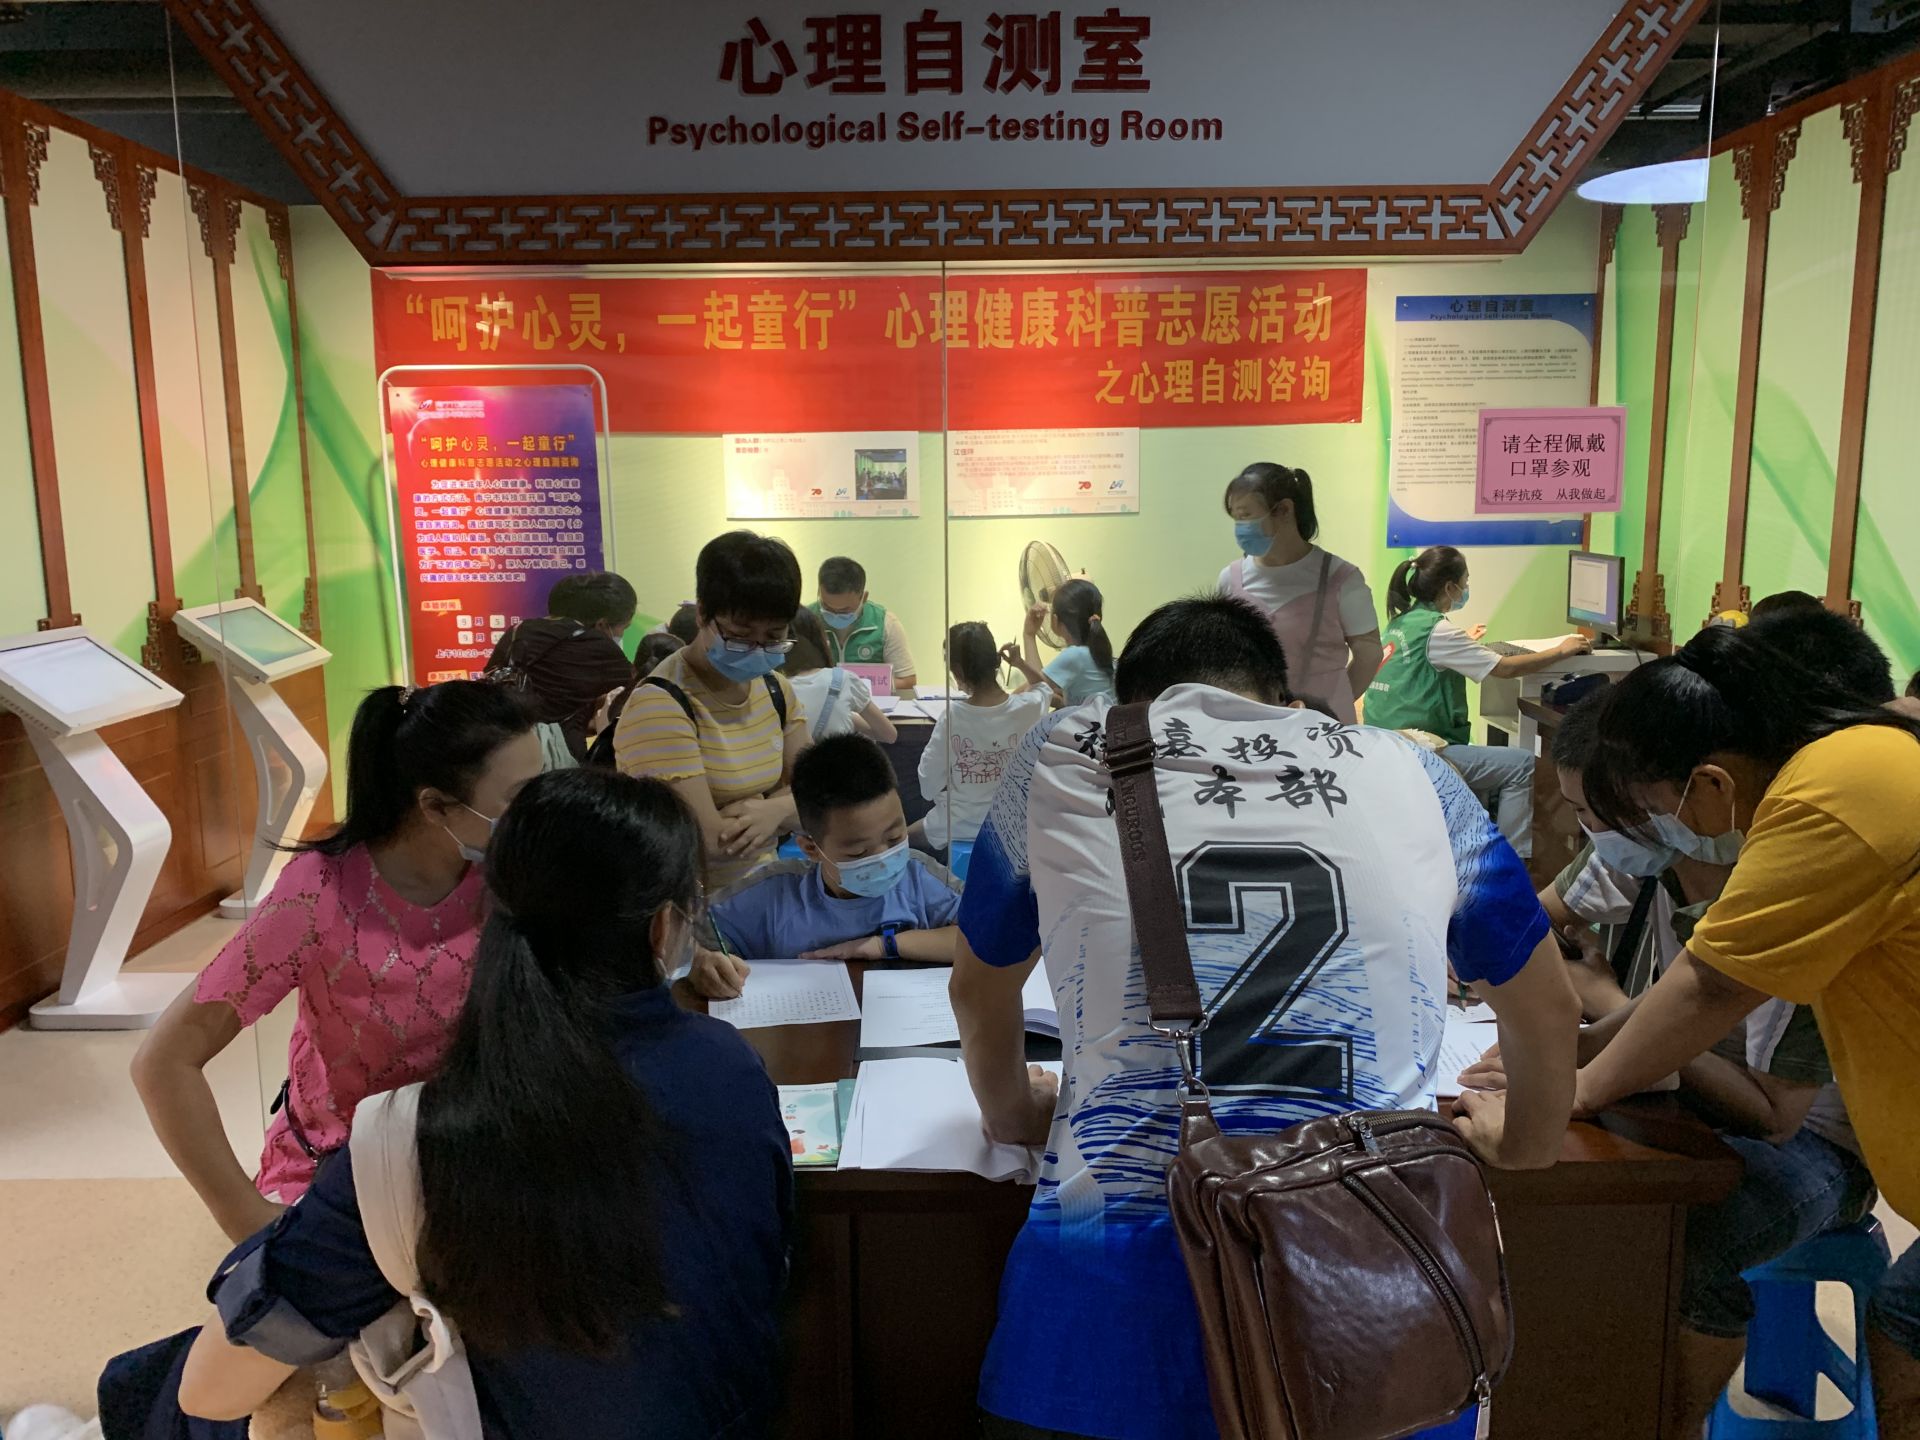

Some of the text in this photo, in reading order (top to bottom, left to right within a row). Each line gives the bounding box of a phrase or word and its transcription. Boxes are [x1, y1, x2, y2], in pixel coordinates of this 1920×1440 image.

[719, 8, 1151, 95] 心理自测室
[648, 109, 1224, 152] Psychological Self-testing Room
[1450, 299, 1534, 313] 心理自测室
[1095, 354, 1331, 405] 之心理自测咨询
[1502, 433, 1605, 454] 请全程佩戴
[1511, 458, 1591, 478] 口罩参观
[1493, 487, 1606, 502] 科学抗疫 从我做起
[1175, 840, 1354, 1102] 2
